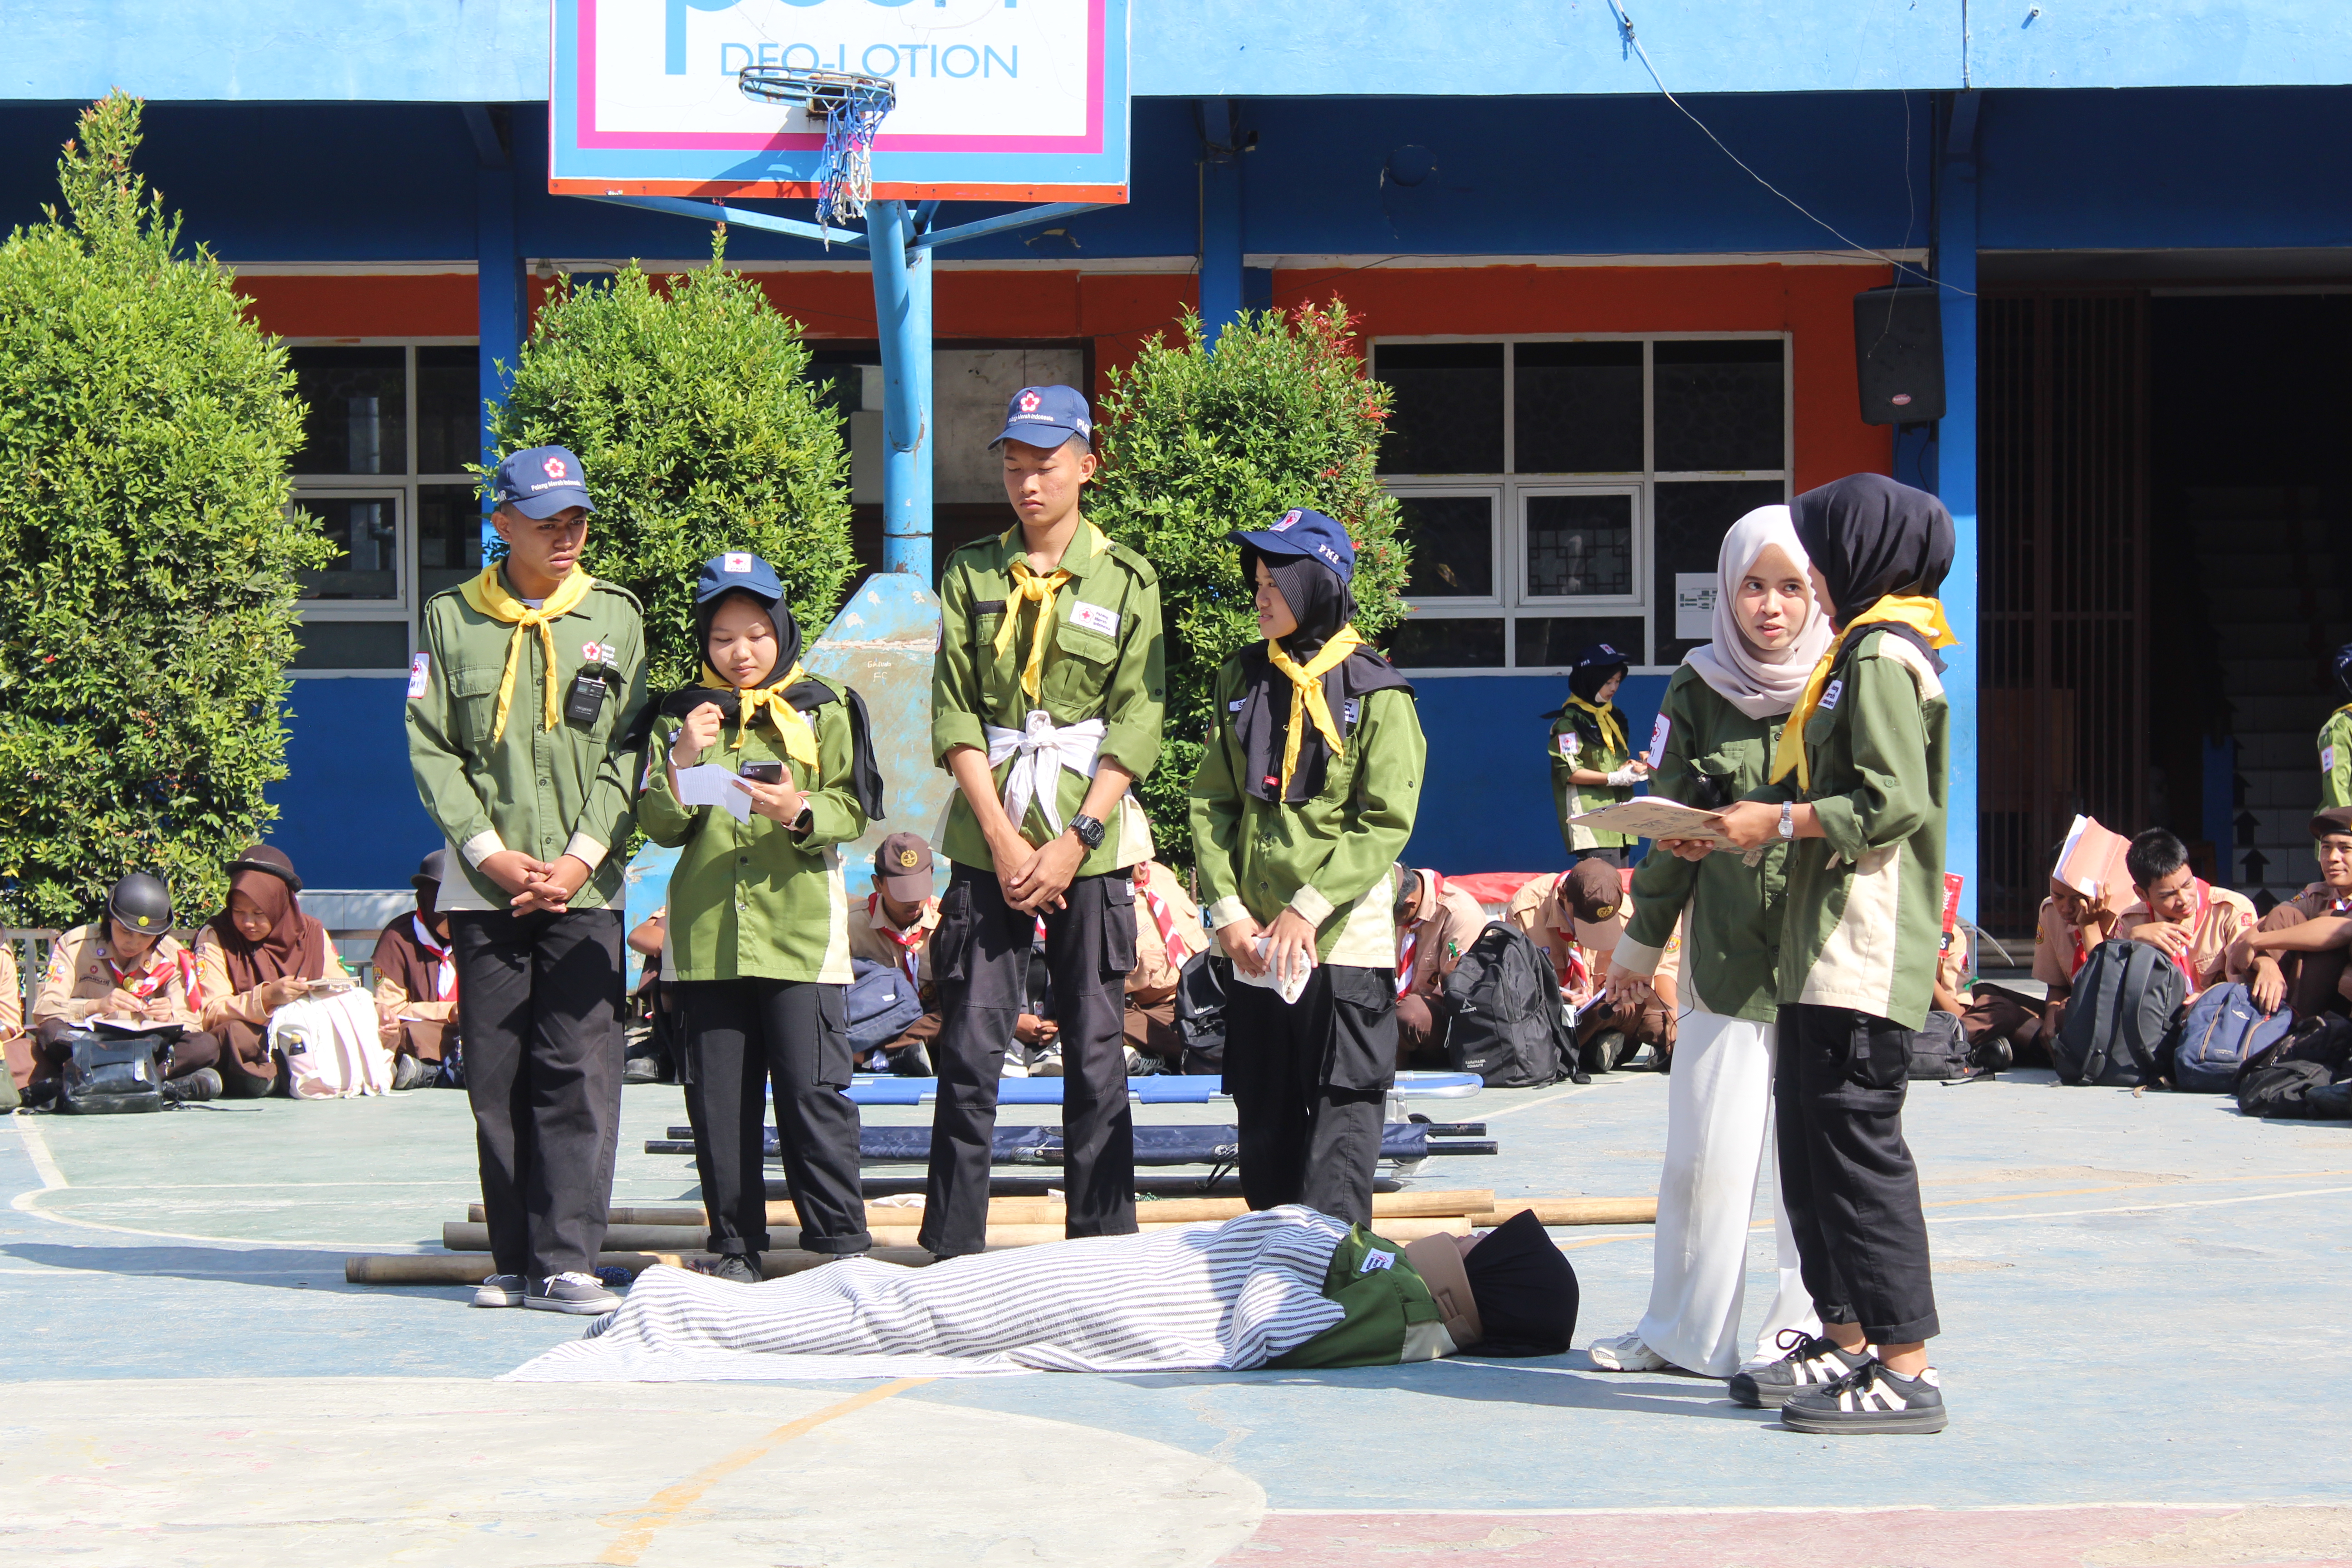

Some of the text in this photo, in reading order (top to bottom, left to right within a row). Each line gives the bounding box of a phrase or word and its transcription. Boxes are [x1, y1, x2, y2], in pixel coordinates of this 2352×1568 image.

[721, 43, 1018, 78] DEO-LOTION
[1031, 413, 1054, 421] Indonesia
[531, 483, 548, 491] Palang
[1318, 544, 1340, 564] PMR
[602, 643, 615, 653] Palang
